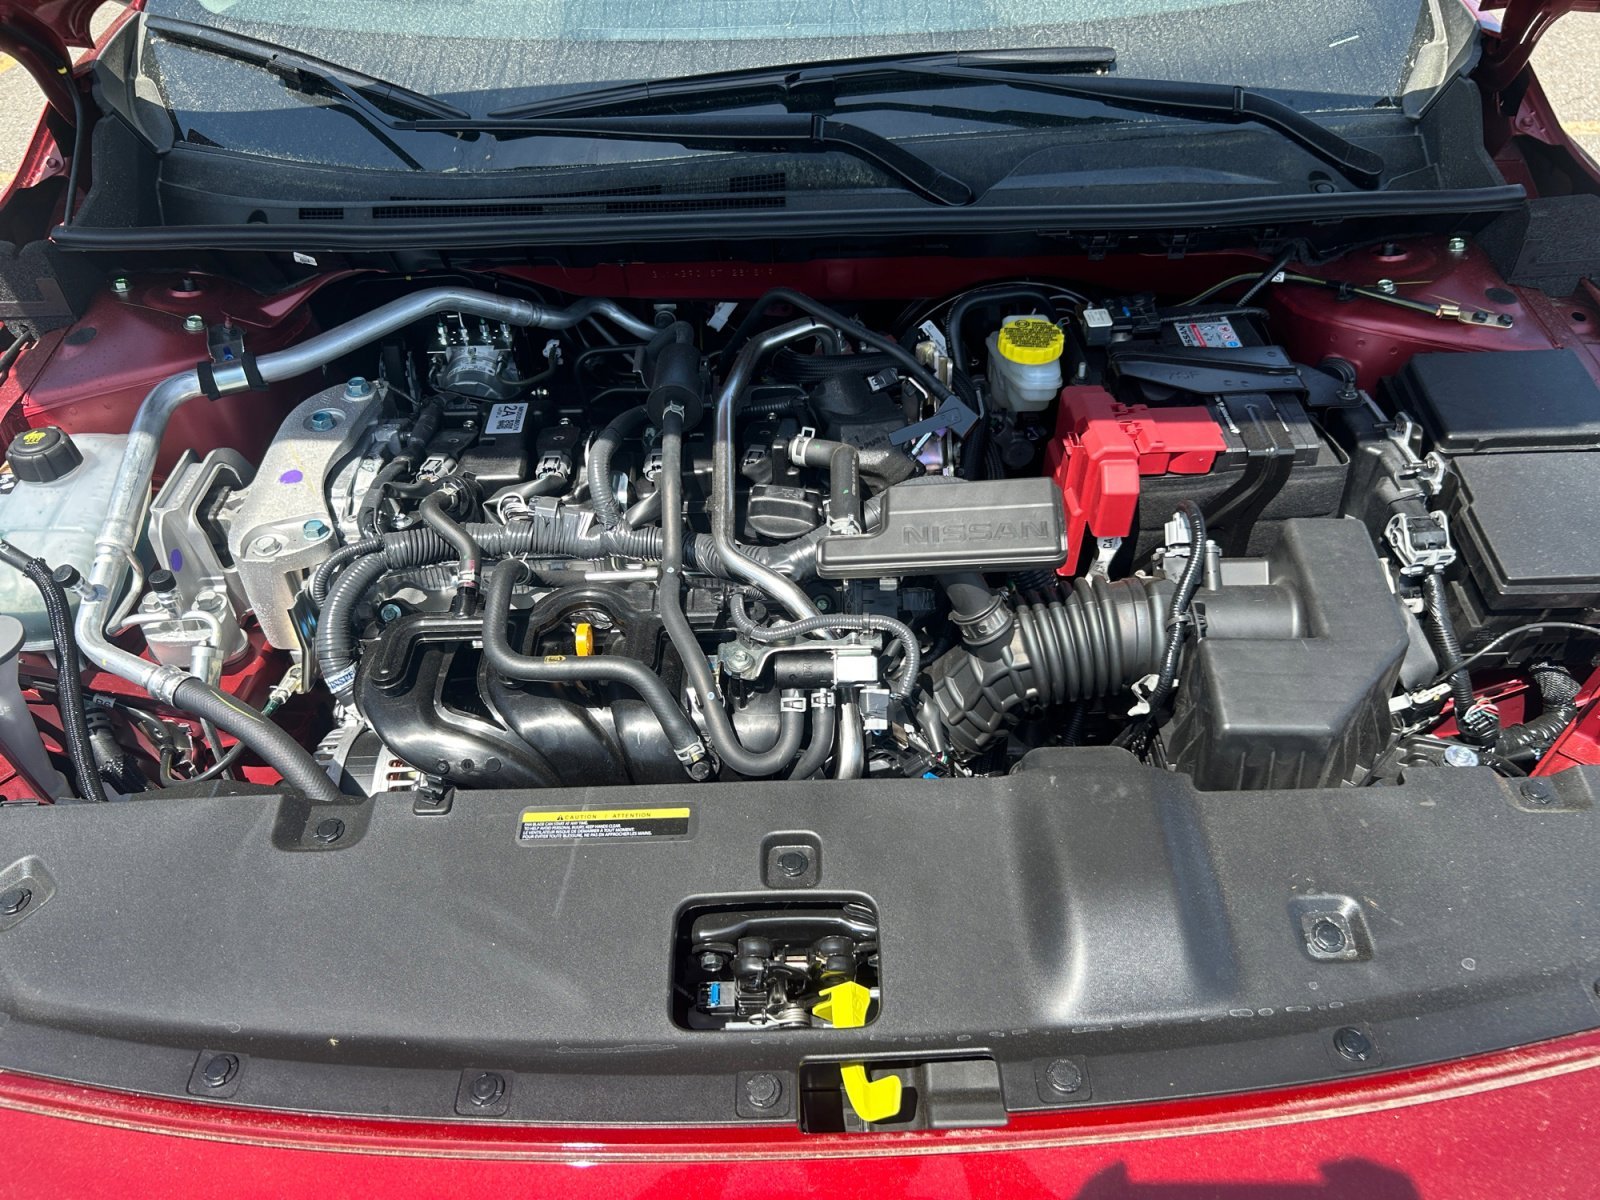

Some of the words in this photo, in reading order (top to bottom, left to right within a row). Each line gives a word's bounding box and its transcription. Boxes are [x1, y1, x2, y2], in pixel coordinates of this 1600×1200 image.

[1179, 326, 1193, 346] ISSAN
[502, 406, 518, 417] 2A
[903, 520, 1049, 546] NISSAN
